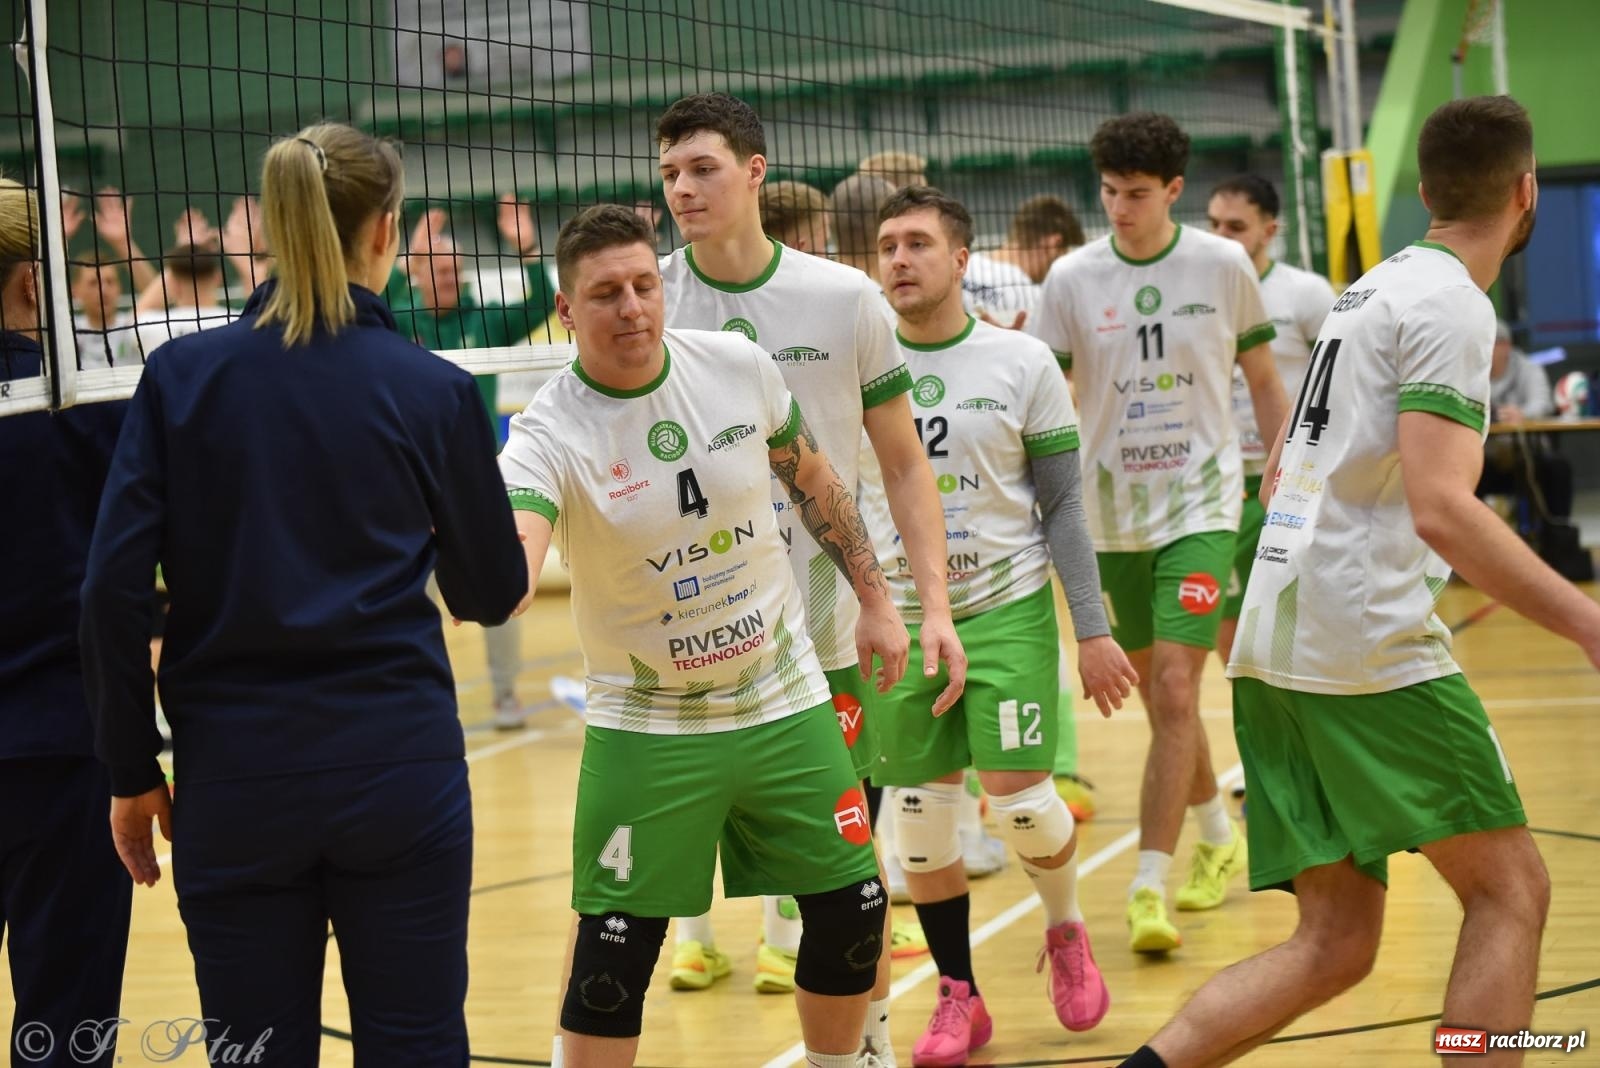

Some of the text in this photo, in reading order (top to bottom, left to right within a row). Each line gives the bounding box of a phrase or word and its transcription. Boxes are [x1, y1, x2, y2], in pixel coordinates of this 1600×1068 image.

[771, 351, 830, 362] AGROTEAM
[1136, 322, 1164, 361] 11
[1112, 372, 1194, 395] VISON
[1285, 338, 1343, 446] 14
[707, 423, 757, 453] AGROTEAM
[1121, 440, 1191, 463] PIVEXIN
[608, 479, 651, 501] Racibórz
[677, 467, 710, 519] 4
[645, 519, 756, 573] VISON
[678, 579, 758, 621] kierunekbmp.pl
[668, 609, 765, 659] PIVEXIN
[673, 630, 766, 672] TECHNOLOGY
[598, 825, 633, 882] 4
[860, 896, 884, 911] errea
[599, 931, 626, 944] errea
